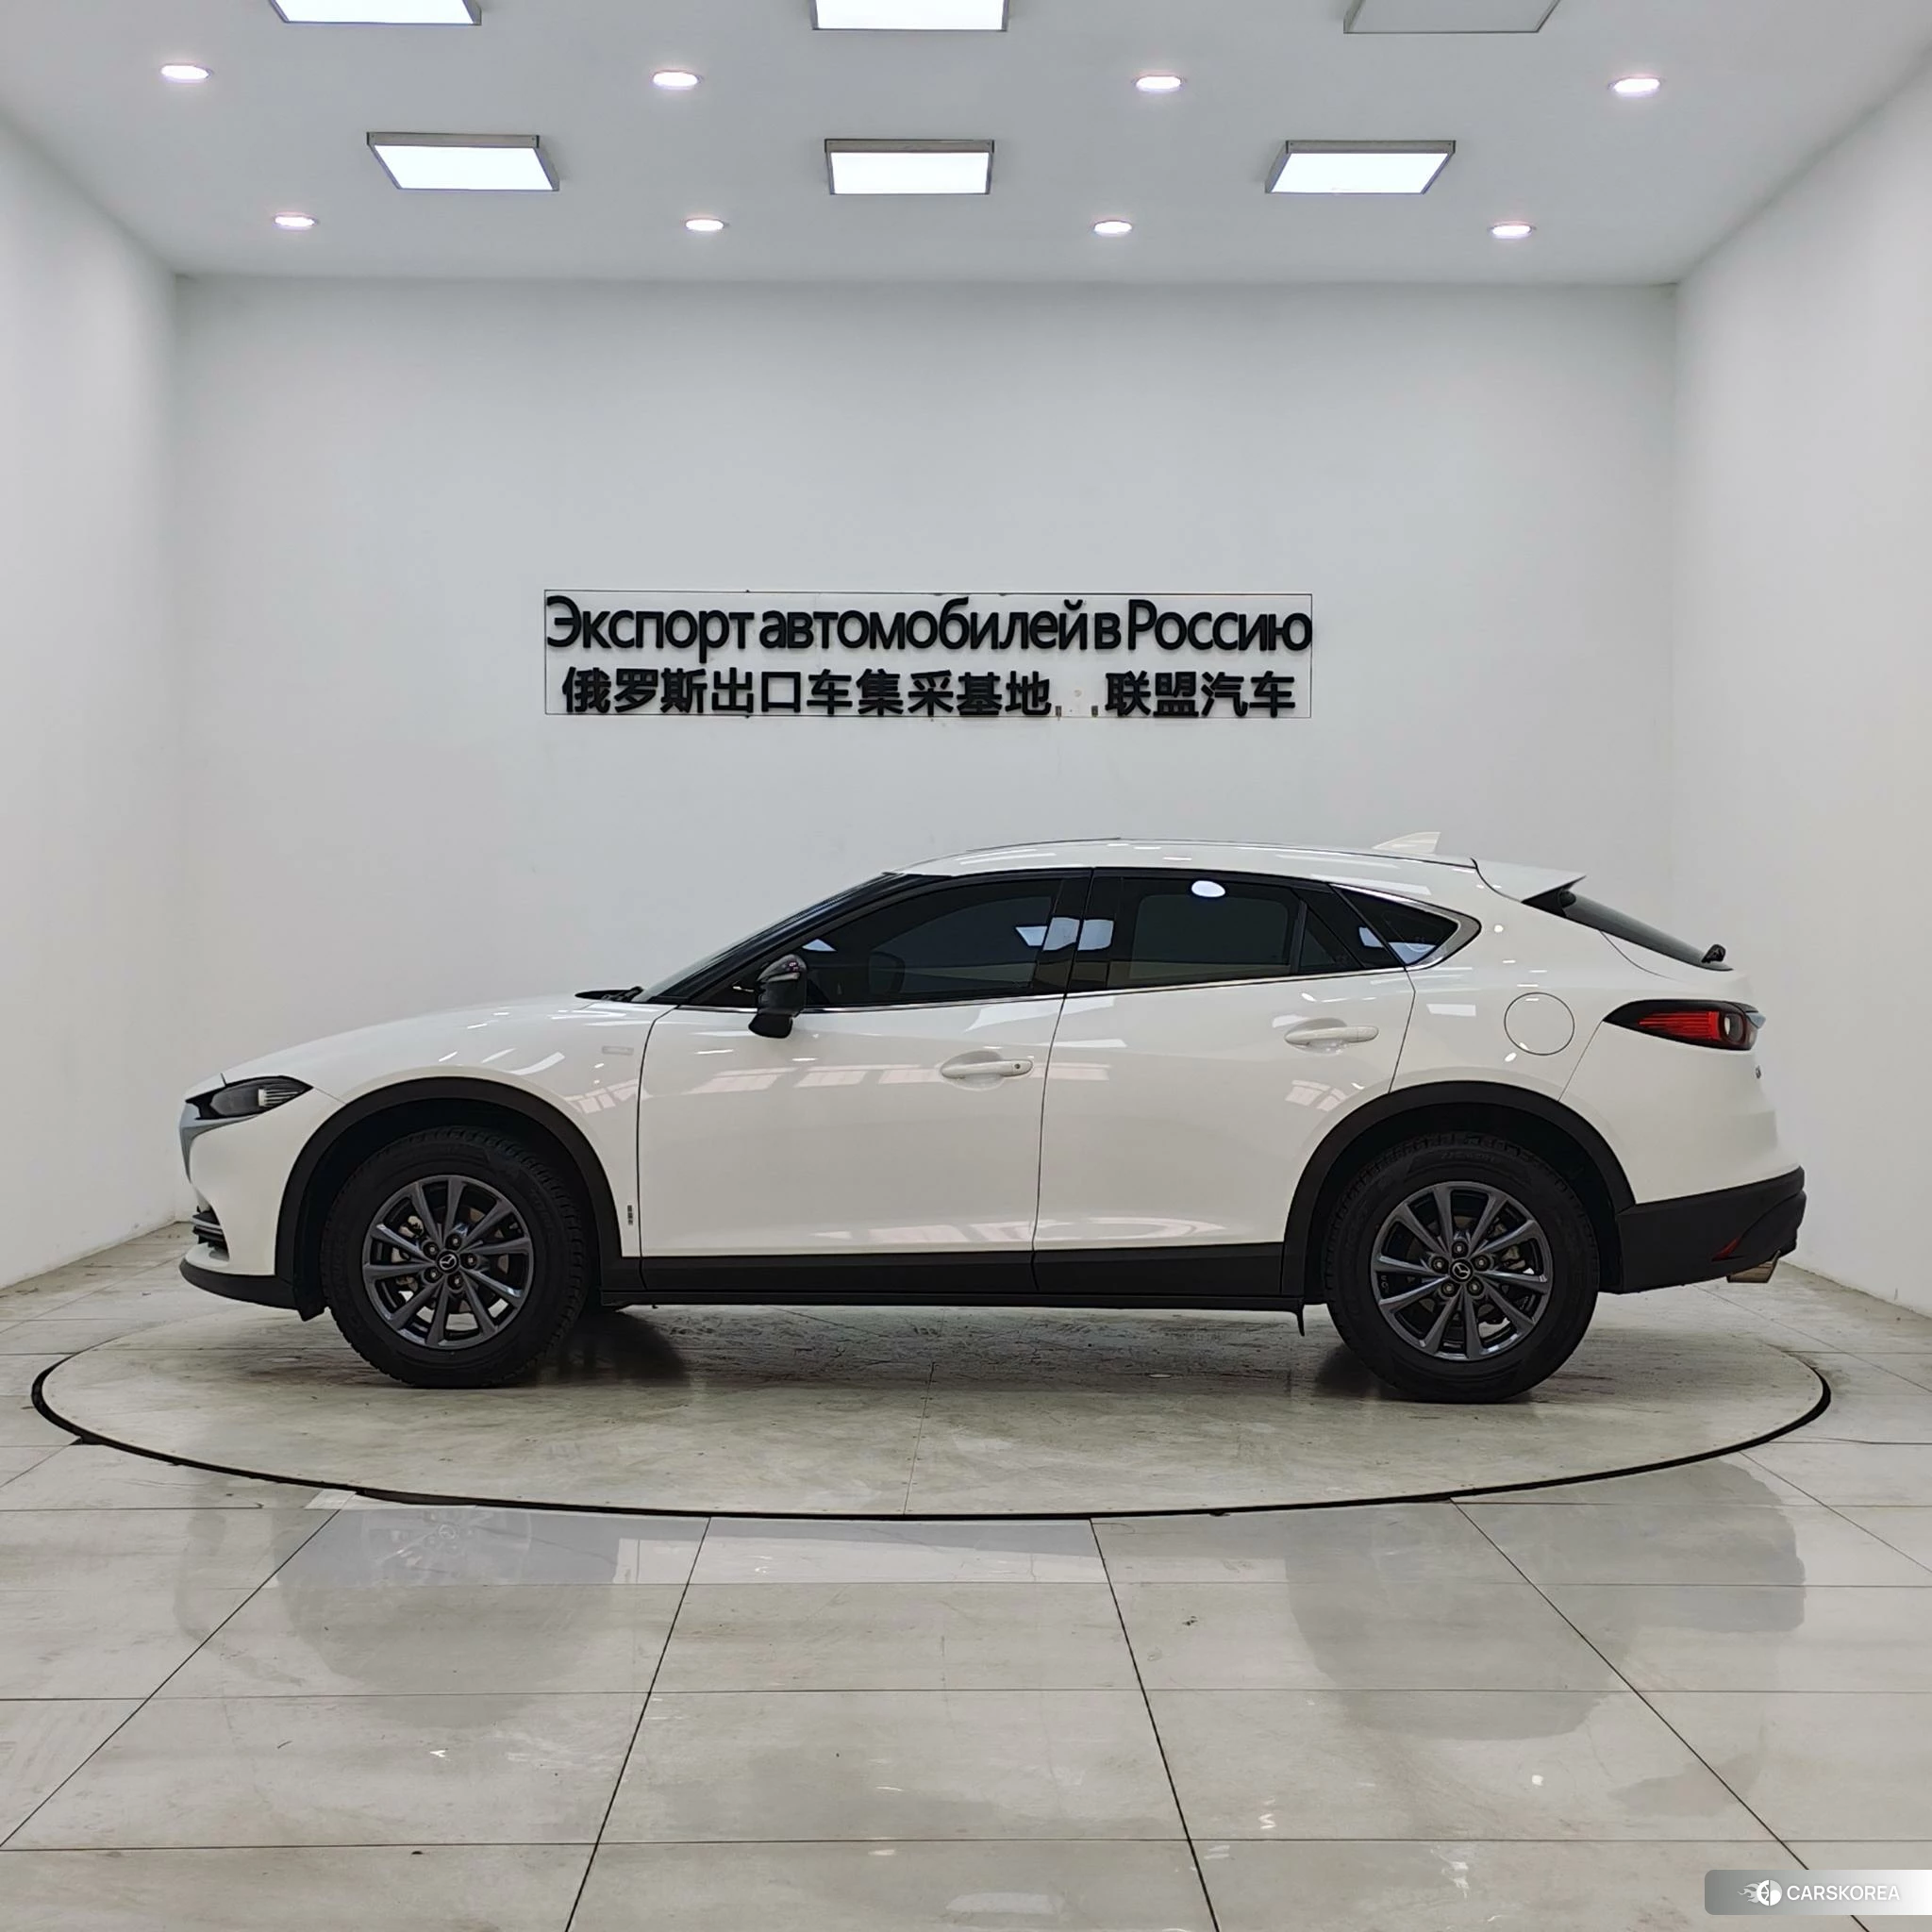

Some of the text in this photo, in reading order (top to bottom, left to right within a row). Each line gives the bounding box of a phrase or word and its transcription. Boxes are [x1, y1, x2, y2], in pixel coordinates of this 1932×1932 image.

[545, 595, 1313, 664] Экспорт автомобилей в Россию
[562, 666, 1296, 718] 俄罗斯出口车集采基地 联盟汽车
